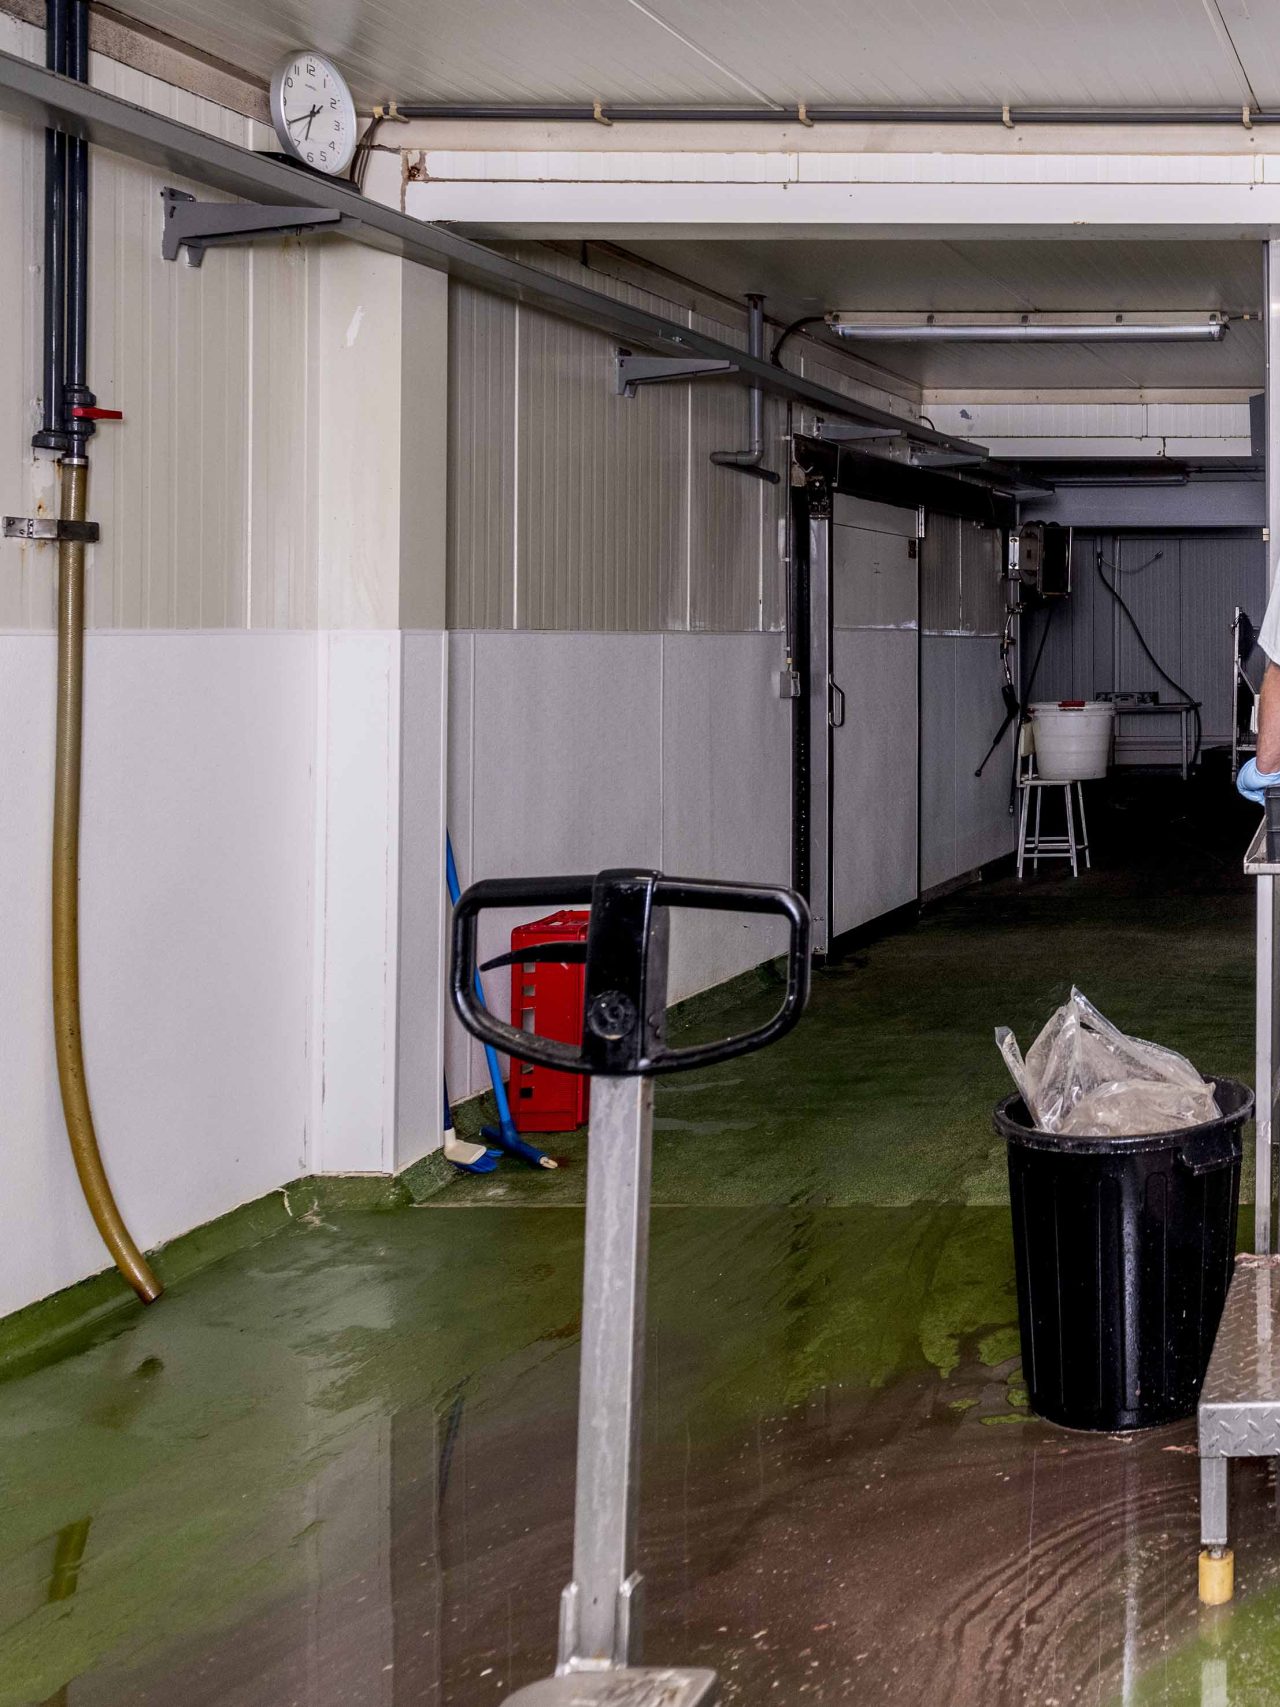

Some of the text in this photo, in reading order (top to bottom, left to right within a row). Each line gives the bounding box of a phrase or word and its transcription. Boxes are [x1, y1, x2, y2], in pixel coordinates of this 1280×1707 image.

[294, 64, 300, 76] 11
[306, 63, 316, 77] 12
[330, 97, 336, 110] 2
[334, 120, 340, 131] 3
[294, 138, 301, 148] 7
[329, 141, 335, 151] 4
[307, 152, 314, 163] 6
[320, 151, 327, 162] 5
